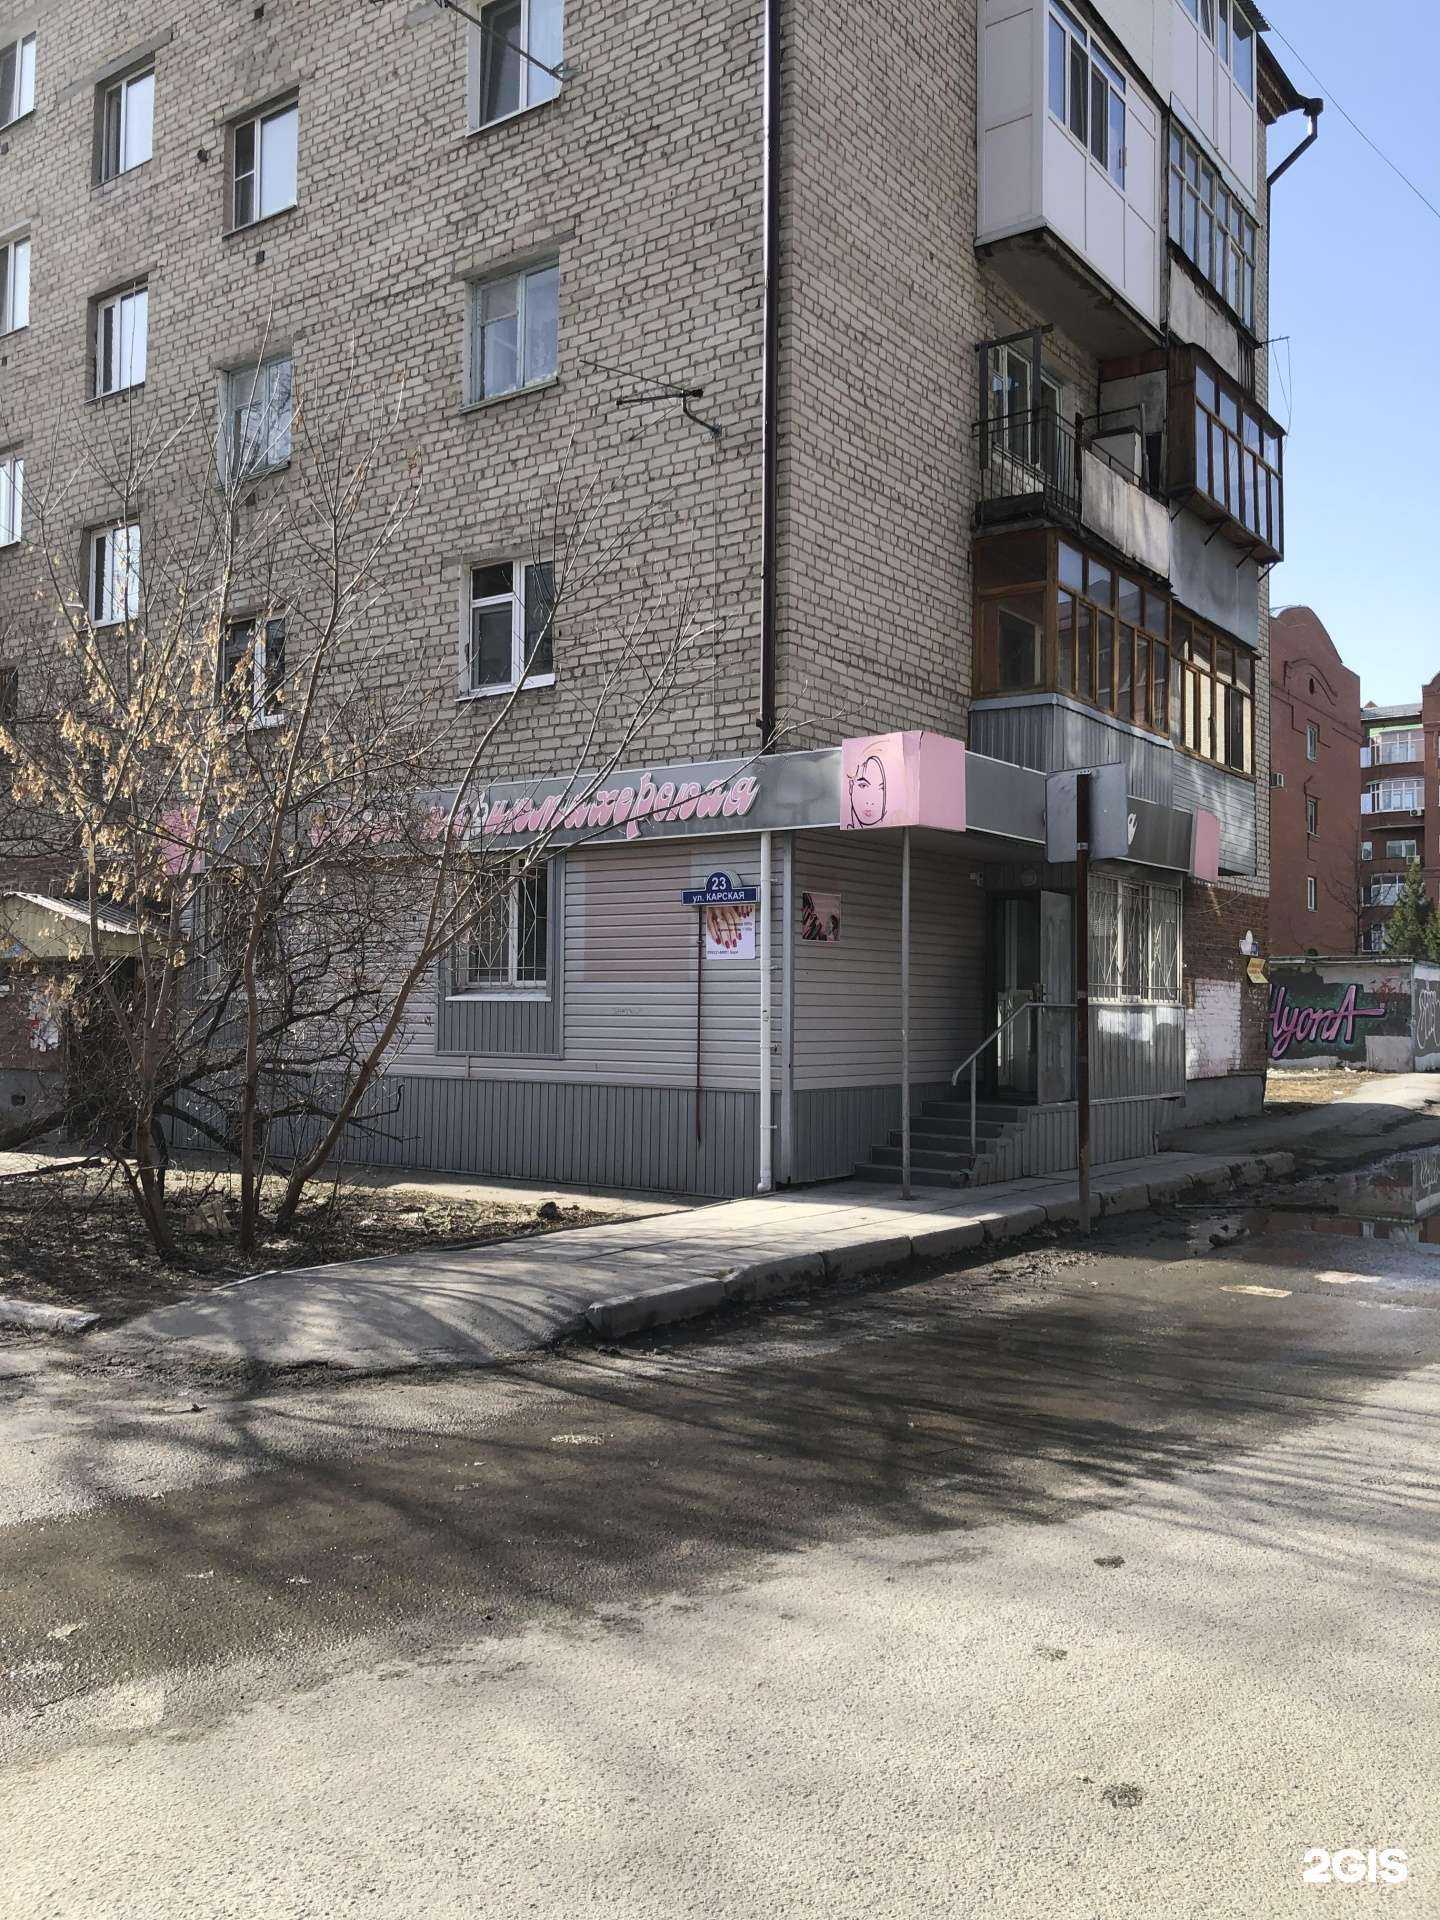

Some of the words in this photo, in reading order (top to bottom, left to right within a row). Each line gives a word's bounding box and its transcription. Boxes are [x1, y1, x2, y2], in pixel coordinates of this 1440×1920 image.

[419, 772, 761, 848] рикмахерская
[711, 877, 726, 890] 23
[693, 895, 704, 904] ул.
[706, 891, 745, 901] КАРСКАЯ
